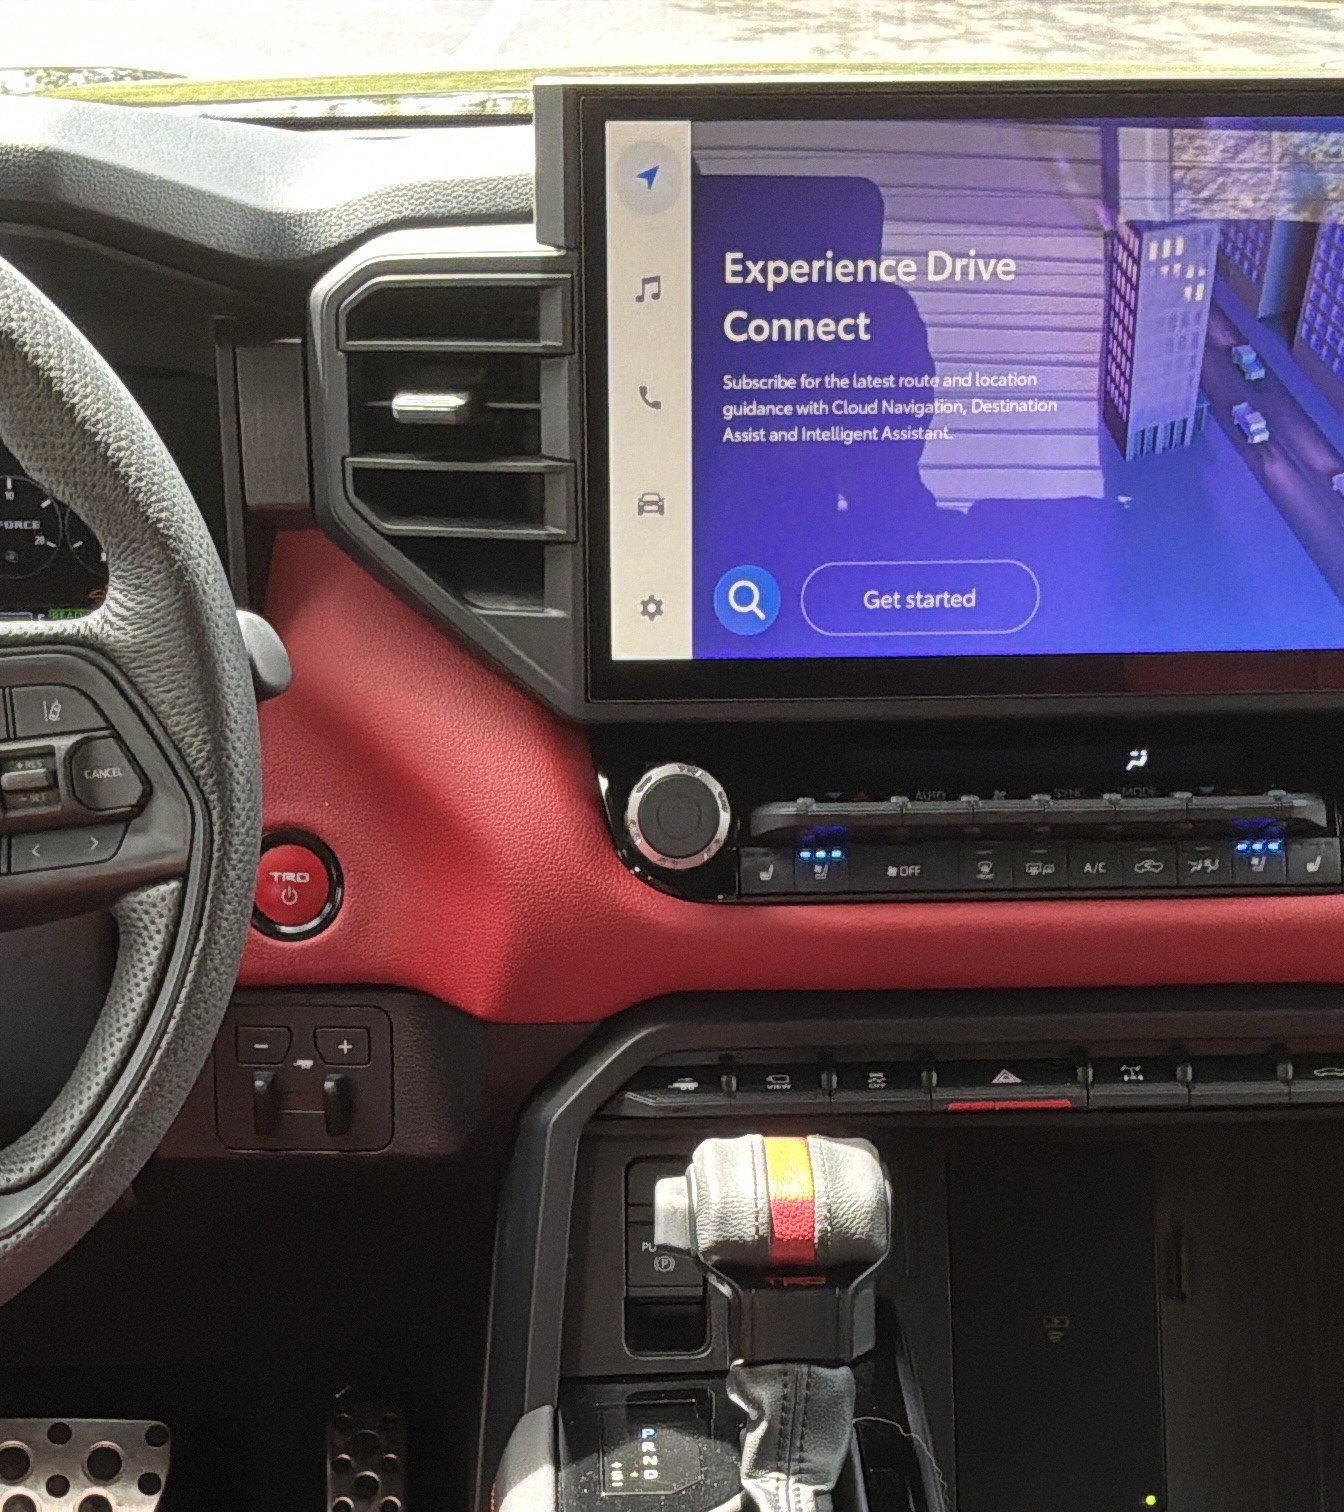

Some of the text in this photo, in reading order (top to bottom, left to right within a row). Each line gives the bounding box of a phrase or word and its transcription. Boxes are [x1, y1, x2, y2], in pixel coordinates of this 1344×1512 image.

[724, 249, 1017, 292] Experience Drive
[723, 310, 872, 342] Connect
[722, 371, 1038, 391] Subscribe for the latest route and location
[722, 398, 1058, 421] guidance with Cloud Navigation, Destination
[722, 426, 956, 446] Assist and Intelligent Assistant.
[35, 535, 47, 546] 20
[863, 588, 976, 610] Get started
[84, 768, 123, 780] CANCEL
[915, 790, 947, 801] AUTO
[900, 865, 921, 877] OFF
[1084, 862, 1106, 875] A/C
[269, 870, 310, 883] TRD
[641, 1427, 656, 1439] P
[641, 1441, 657, 1453] R
[643, 1455, 658, 1466] N
[643, 1469, 658, 1481] D
